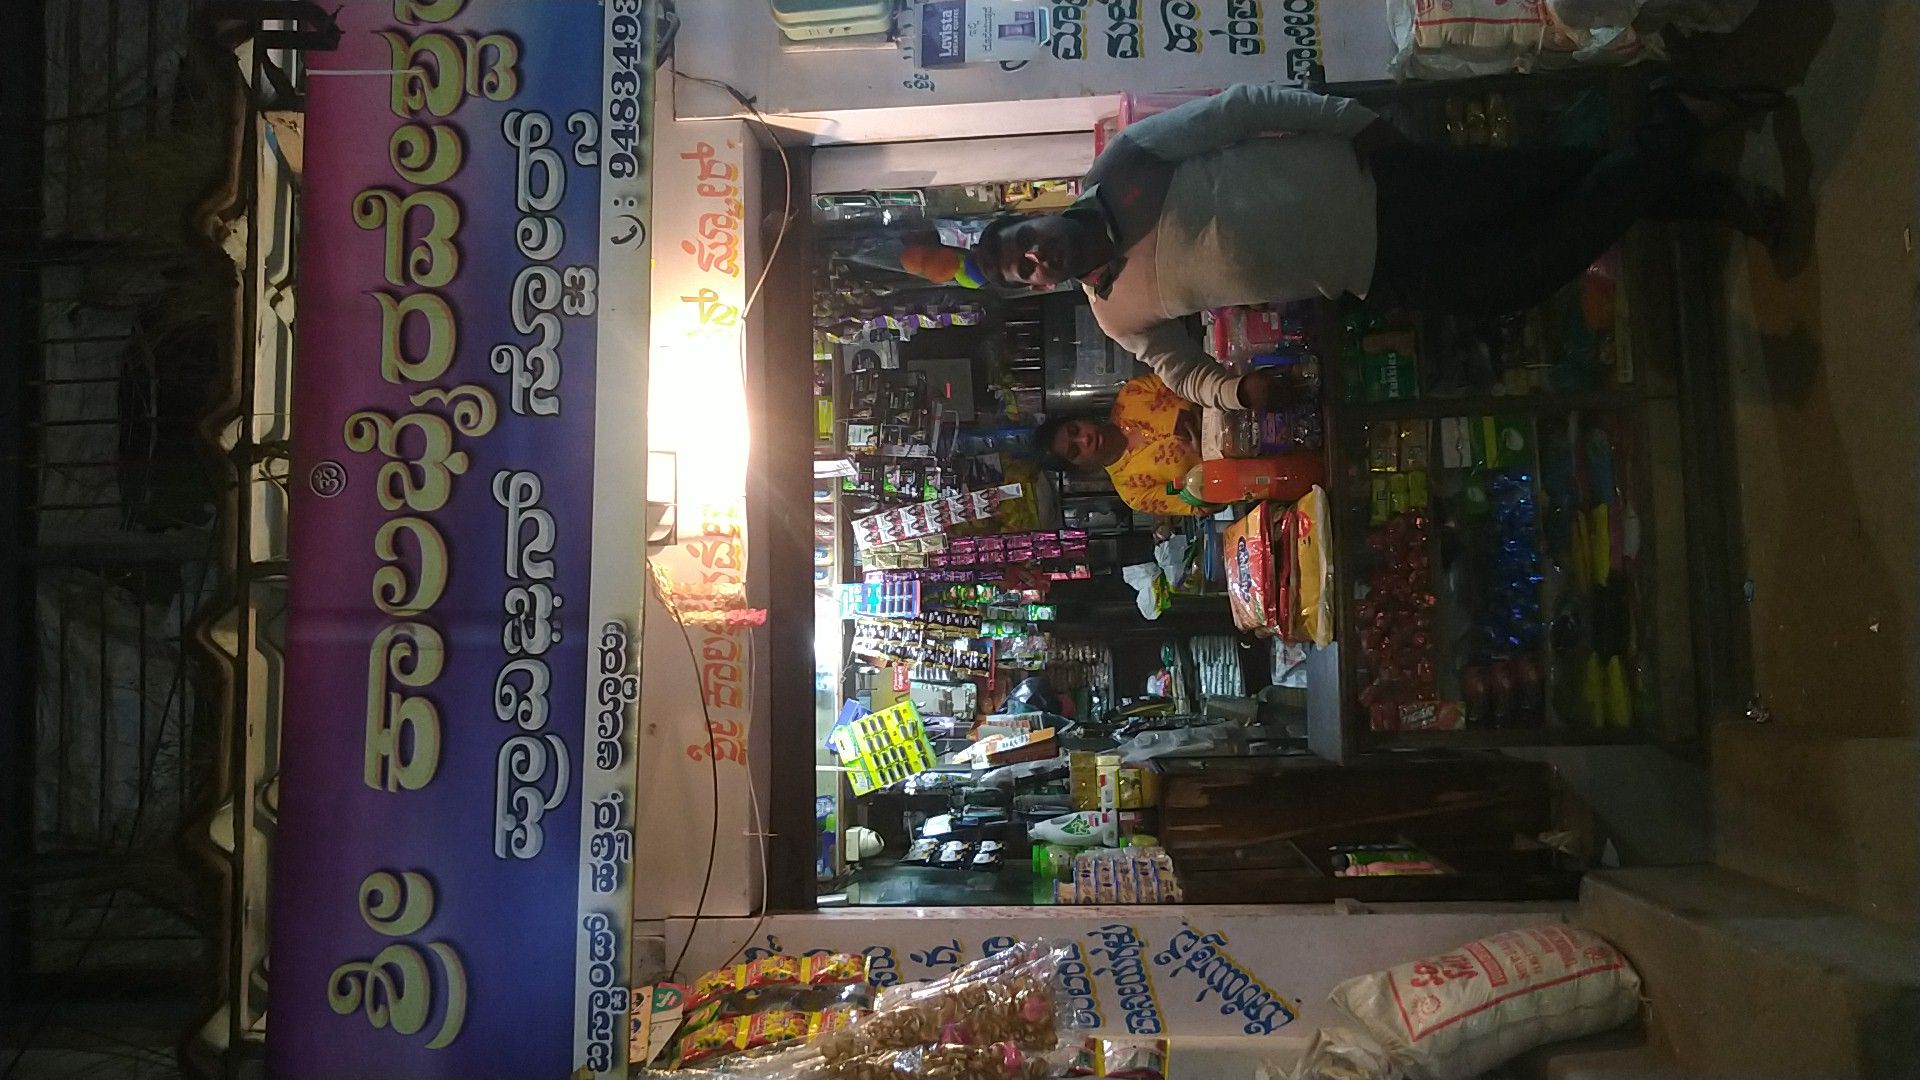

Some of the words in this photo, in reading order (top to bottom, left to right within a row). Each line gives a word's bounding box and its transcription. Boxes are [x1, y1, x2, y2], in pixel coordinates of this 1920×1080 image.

[938, 9, 953, 57] Levista
[490, 111, 598, 415] ಸ್ಟೋರ್ಸ್
[343, 0, 519, 792] ಕಾಲಭೈರವೇಶ್ವ
[686, 720, 746, 766] ಶ್ರೀ
[327, 872, 467, 1049] ಶ್ರೀ
[583, 914, 627, 1072] ಬಸ್ಟಾಂಡ್
[1087, 924, 1161, 1034] ಪಾನೀಯಗಳು
